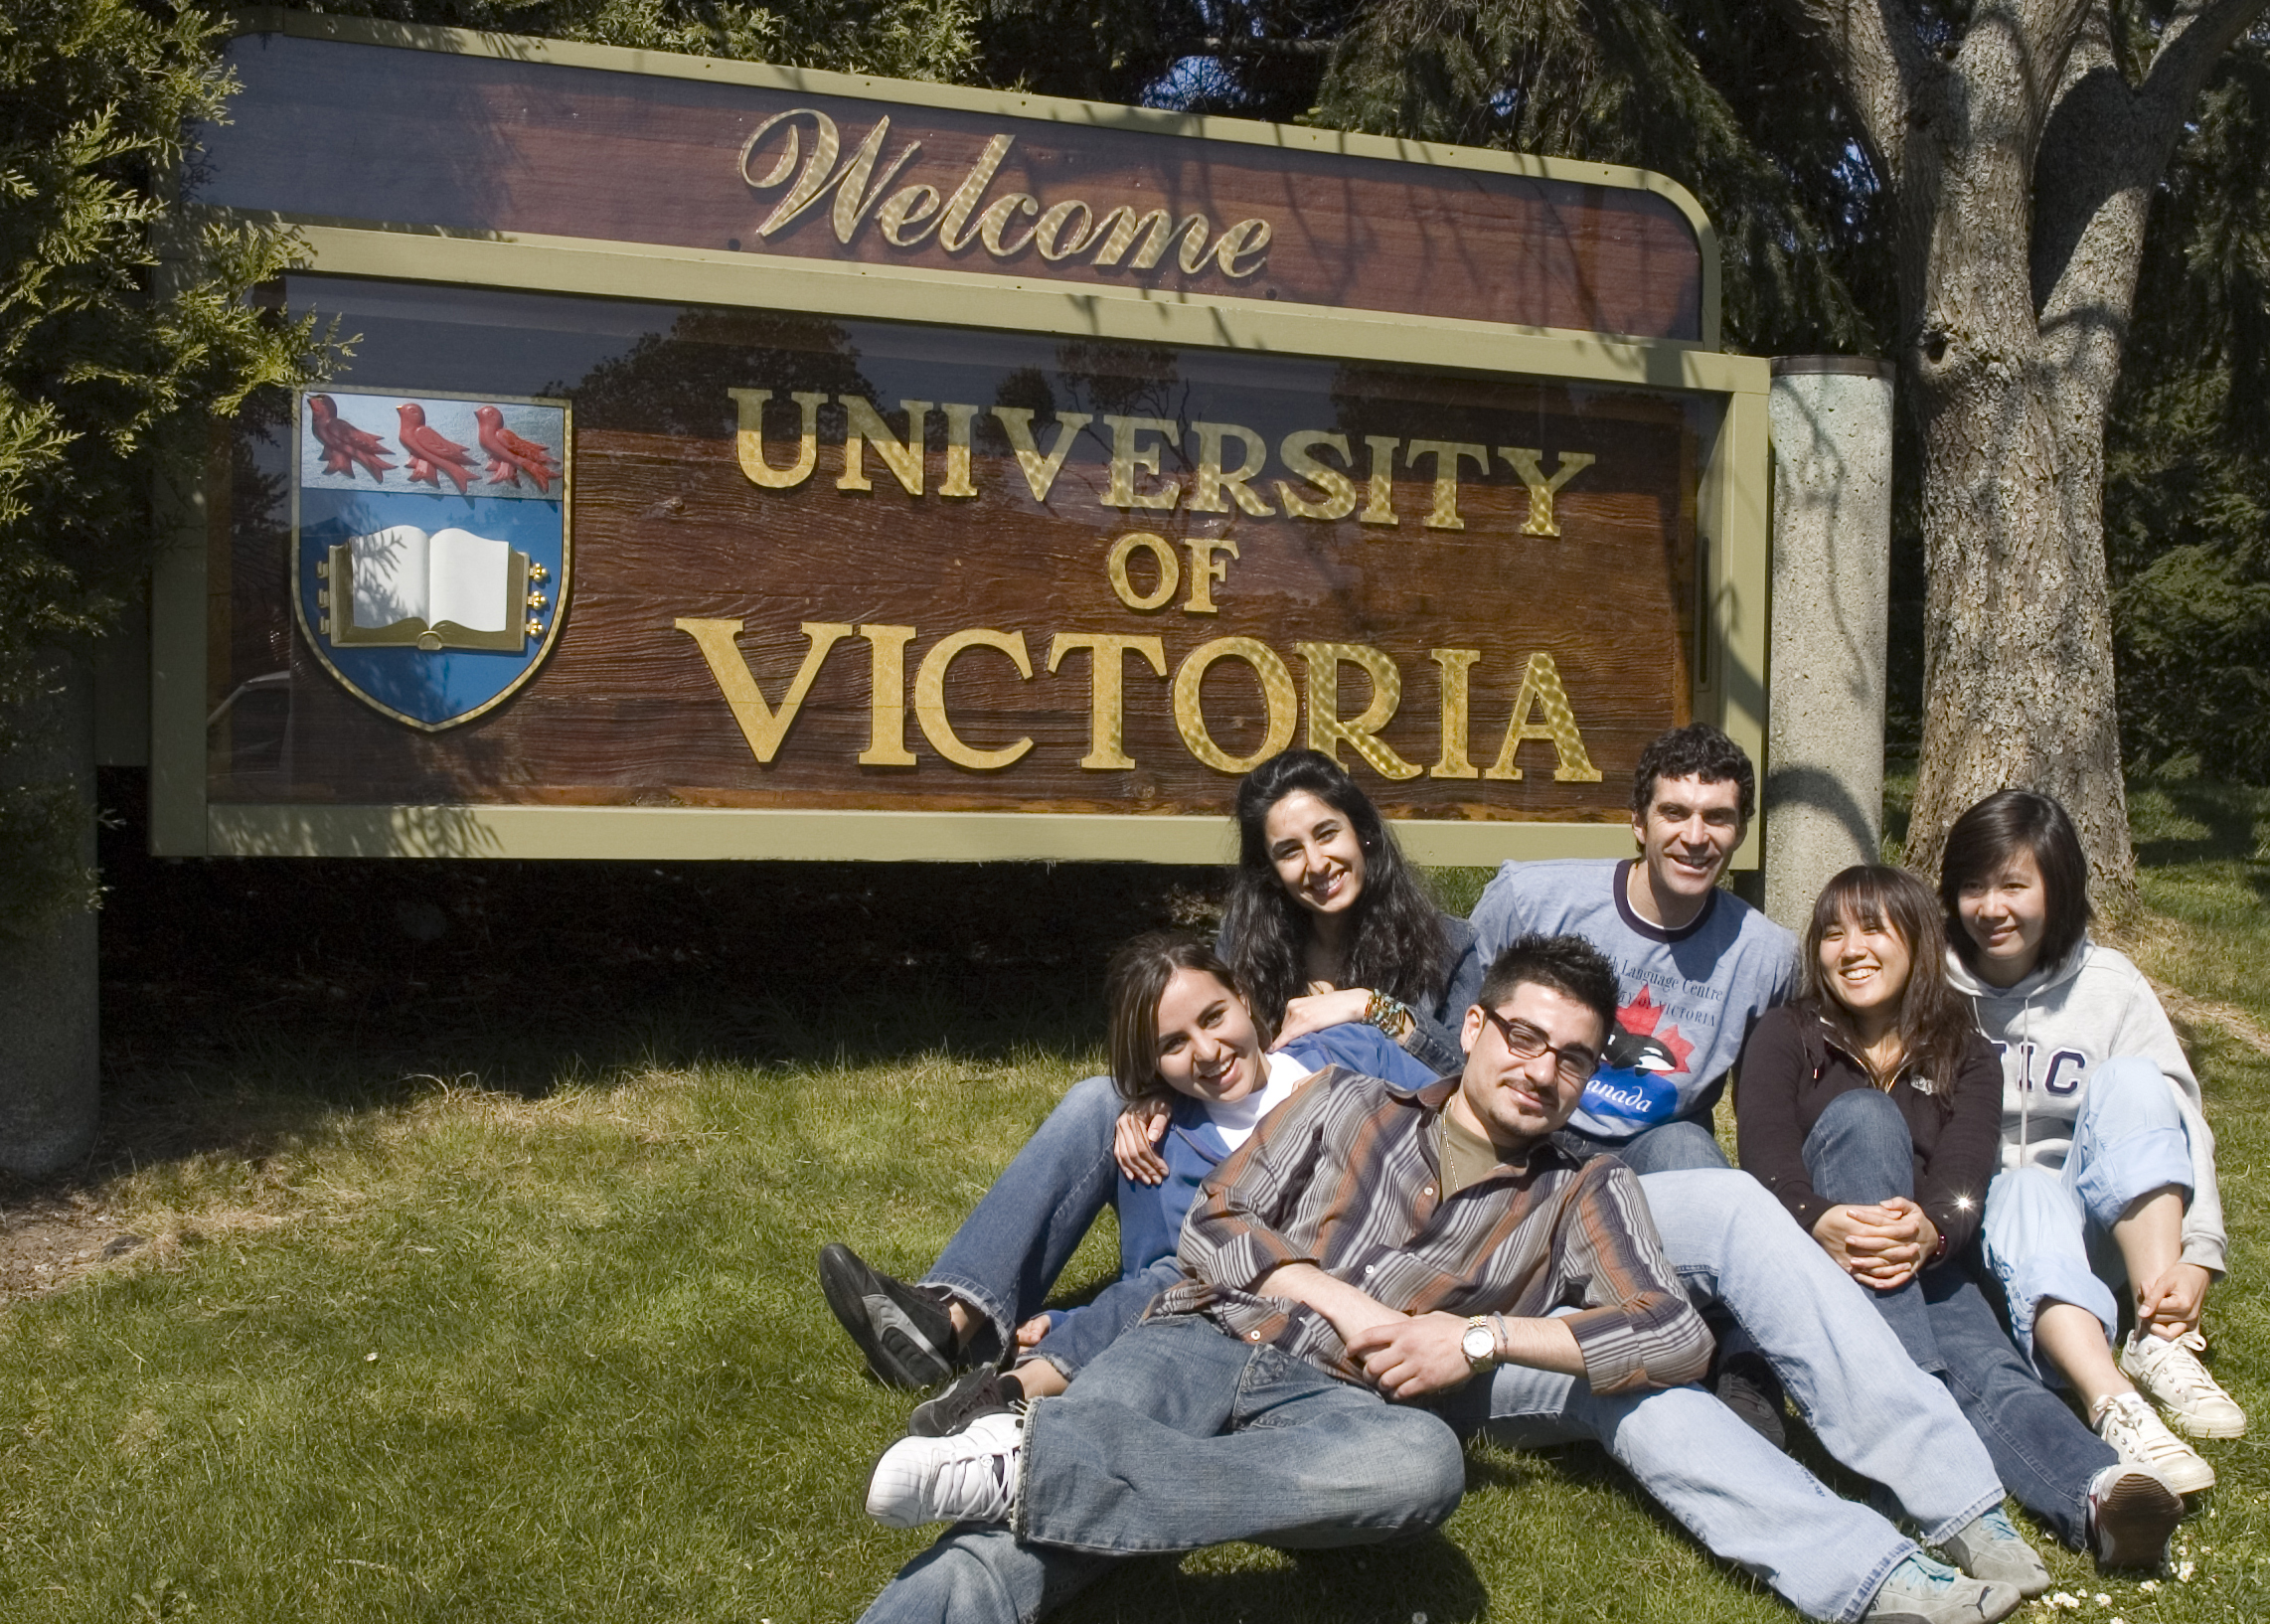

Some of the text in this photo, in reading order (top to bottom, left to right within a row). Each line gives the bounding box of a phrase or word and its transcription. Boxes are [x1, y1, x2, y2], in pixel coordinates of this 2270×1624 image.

[738, 107, 1272, 278] Welcome
[728, 387, 1596, 538] UNIVERSITY
[1107, 532, 1239, 613] OF
[674, 617, 1603, 783] VICTORIA
[1621, 959, 1679, 993] Language
[1682, 978, 1723, 1002] Centre
[1658, 1000, 1715, 1027] VICTORIA
[1585, 1079, 1653, 1113] anada
[1990, 1042, 2087, 1096] IC
